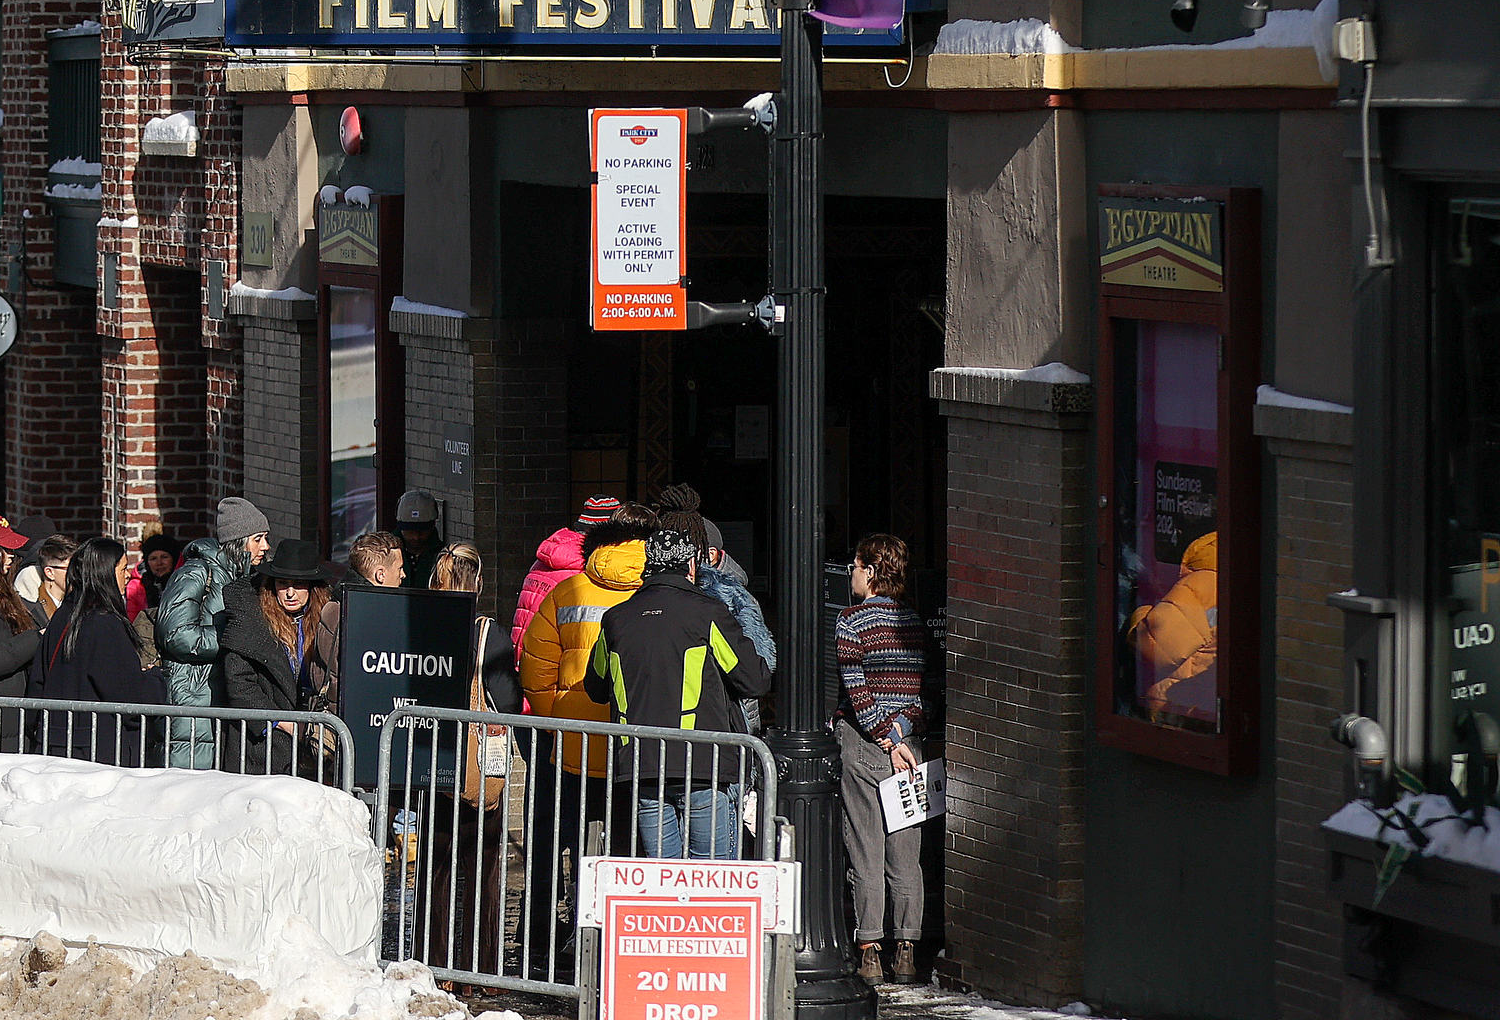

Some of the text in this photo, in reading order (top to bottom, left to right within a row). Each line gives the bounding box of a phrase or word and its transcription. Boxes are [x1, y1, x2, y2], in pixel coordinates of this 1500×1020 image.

[605, 158, 672, 169] NO PARKING
[616, 184, 661, 195] SPECIAL
[620, 198, 656, 208] EVENT
[322, 209, 374, 241] EGYPTIAN
[617, 223, 657, 234] ACTIVE
[1105, 207, 1213, 256] EGYPTIAN
[614, 237, 662, 247] LOADING
[603, 250, 674, 260] WITH PERMIT
[624, 263, 653, 273] ONLY
[1143, 265, 1177, 281] THEATRE
[606, 293, 673, 305] NO PARKING
[601, 307, 678, 318] 2:00-6:00 A.M.
[444, 440, 470, 456] VOLUNTEER
[1156, 469, 1202, 493] Sundance
[1156, 491, 1176, 513] Film
[362, 651, 453, 677] CAUTION
[393, 697, 418, 710] WET
[370, 713, 440, 730] ICY URFAC
[615, 867, 759, 890] NO PARKING
[624, 914, 745, 934] SUNDANCE
[623, 938, 745, 955] FILM FESTIVAL
[637, 971, 727, 992] 20 MIN
[646, 1003, 718, 1020] DROP
